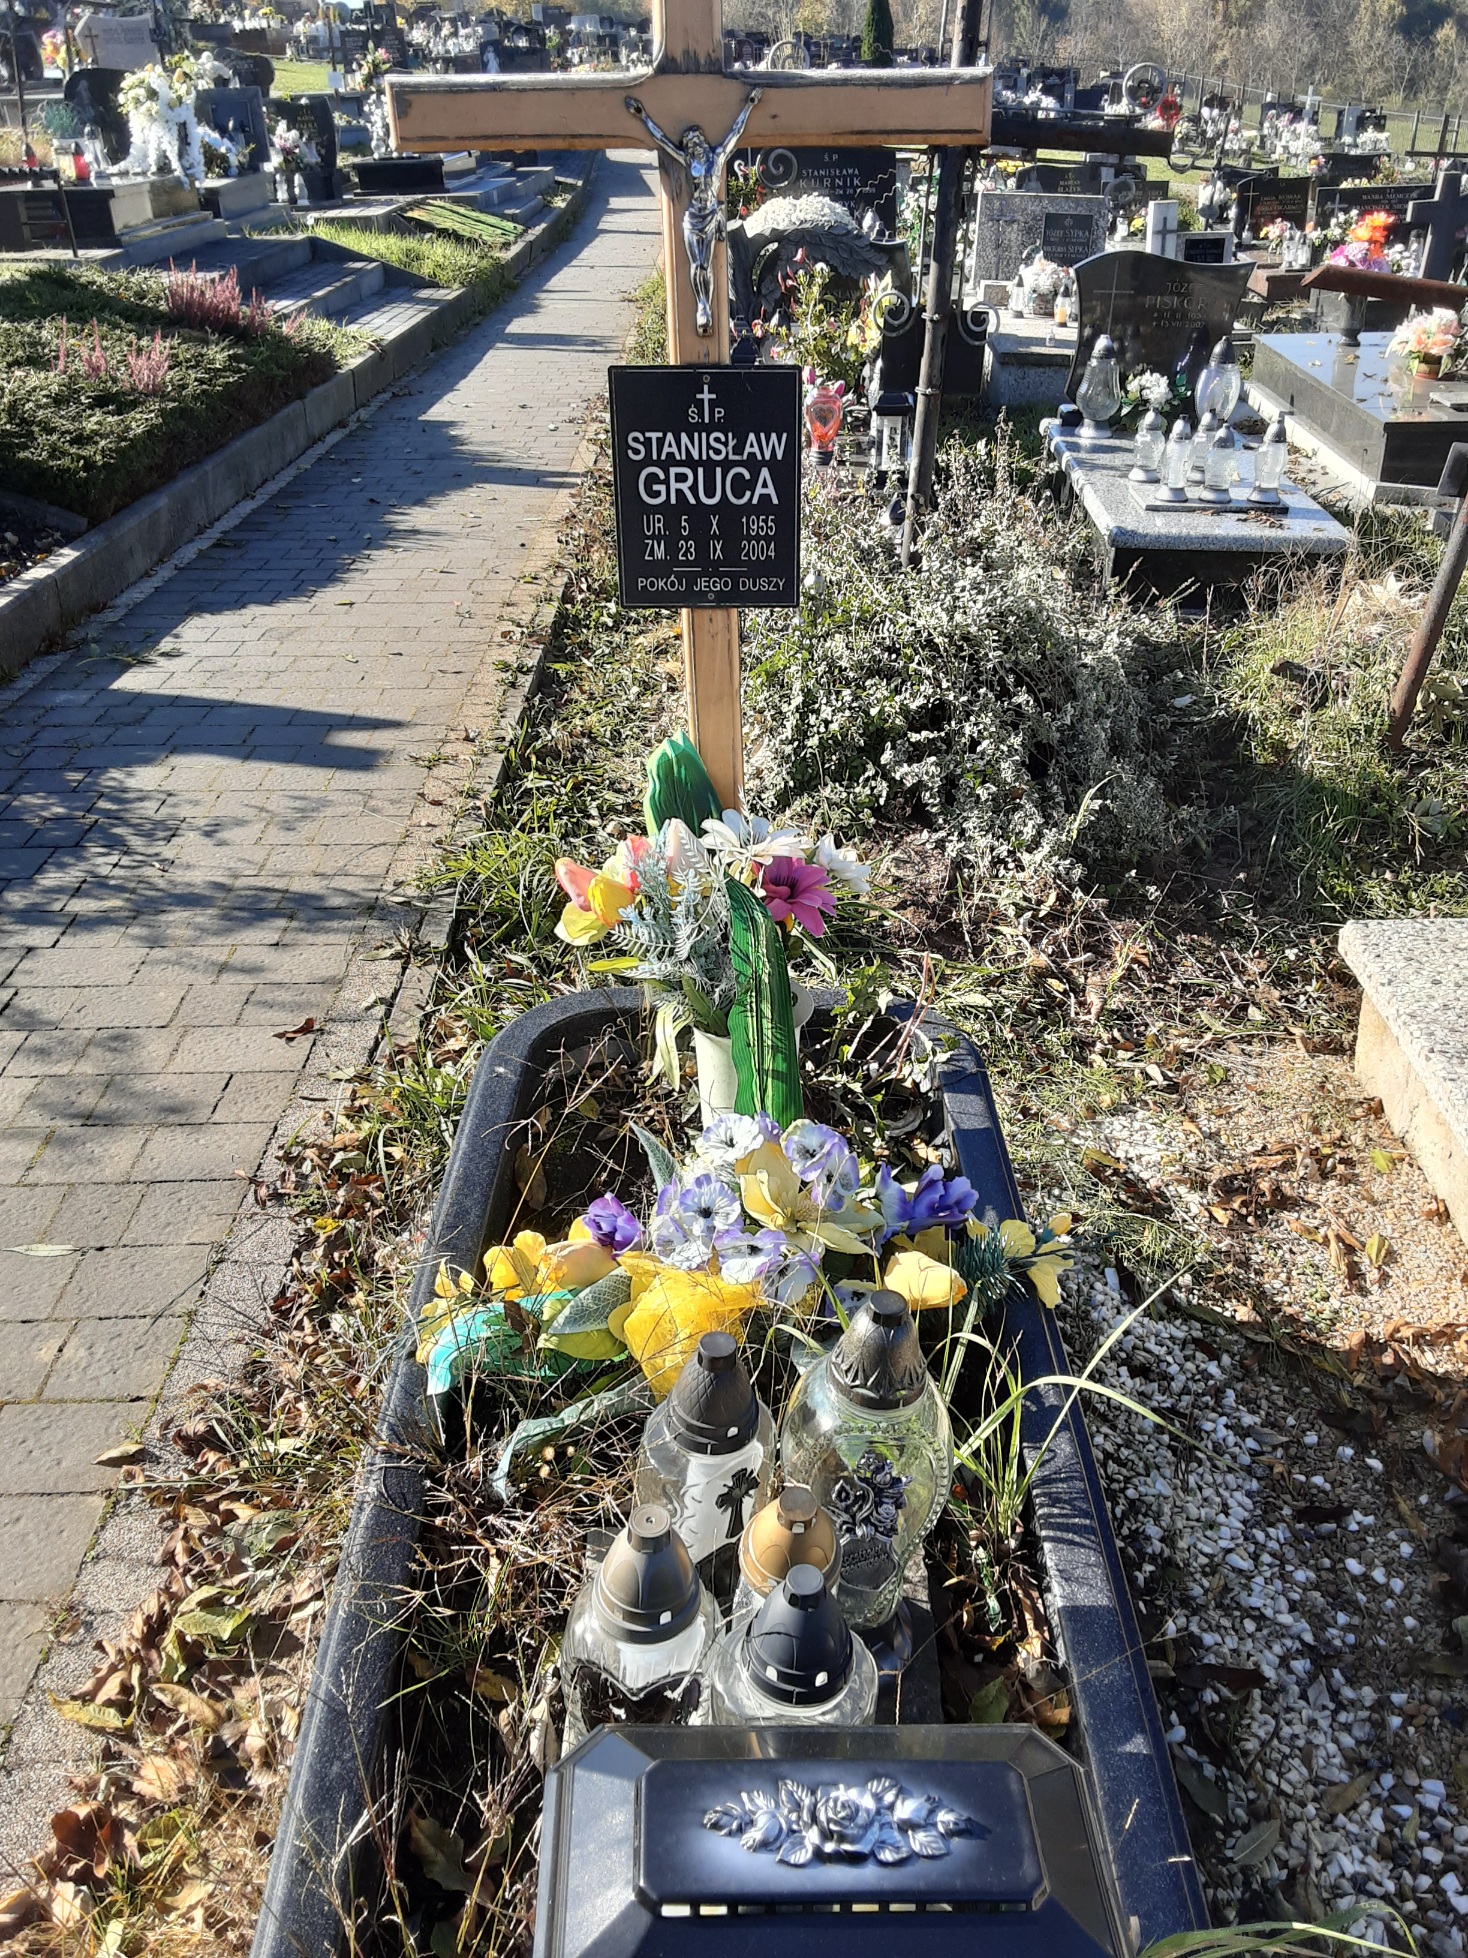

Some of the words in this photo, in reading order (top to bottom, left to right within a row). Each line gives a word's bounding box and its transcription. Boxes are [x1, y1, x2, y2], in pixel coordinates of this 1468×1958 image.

[799, 177, 862, 188] KURNIK
[801, 168, 860, 177] STANISŁAWA
[1065, 229, 1090, 238] SYPKA
[627, 431, 787, 461] STANISŁAW
[638, 466, 779, 506] GRUCA
[643, 514, 669, 536] UR.
[681, 515, 690, 536] 5
[710, 514, 720, 536] X
[741, 515, 776, 536] 1955
[644, 539, 670, 561] ZM.
[678, 540, 696, 561] 23
[709, 540, 723, 561] IX
[741, 540, 776, 561] 2004
[637, 574, 686, 591] POKÓJ
[693, 577, 732, 592] JEGO
[739, 577, 786, 592] DUSZY
